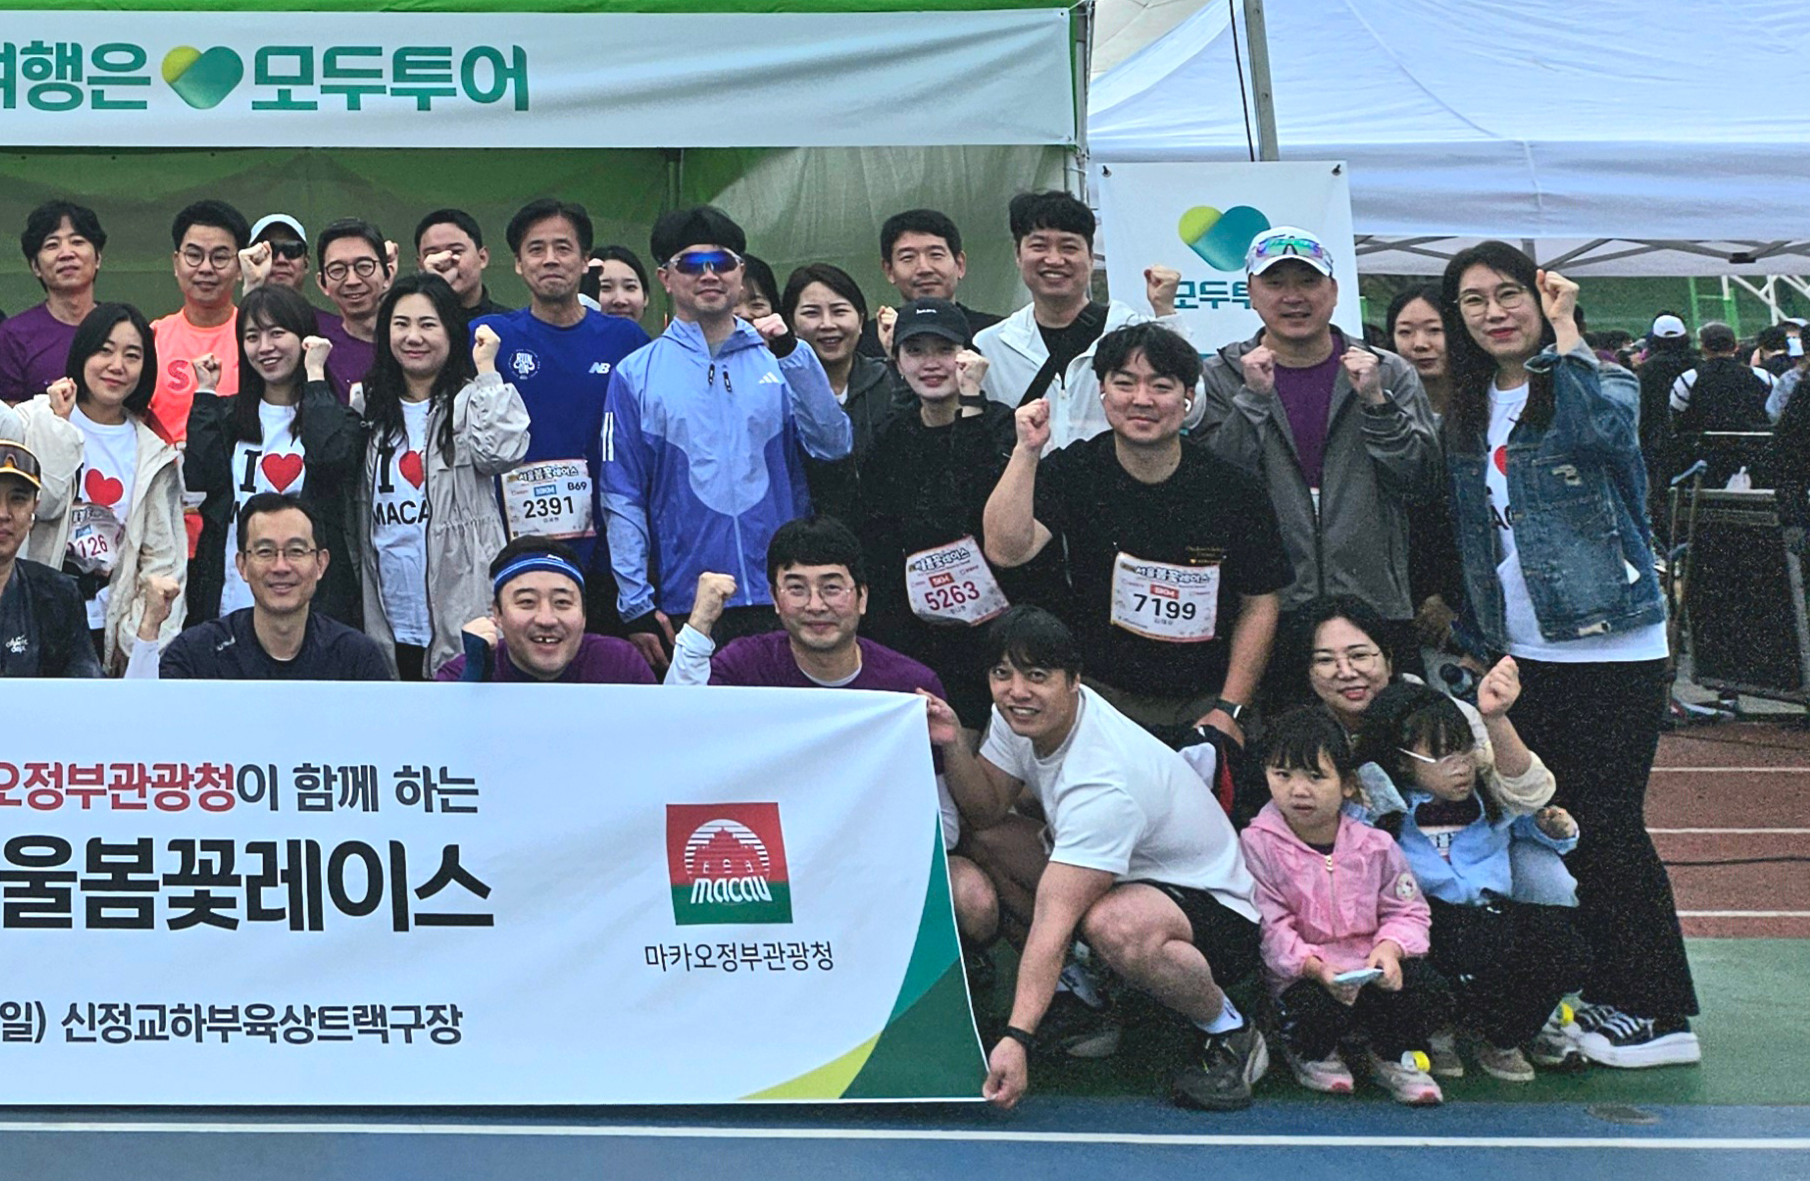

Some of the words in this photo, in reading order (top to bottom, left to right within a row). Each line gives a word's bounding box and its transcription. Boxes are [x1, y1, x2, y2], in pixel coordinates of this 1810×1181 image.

[251, 44, 530, 112] 모두투어
[239, 448, 263, 494] I
[567, 482, 588, 491] B69
[523, 496, 574, 519] 2391
[924, 581, 980, 611] 5263
[1133, 593, 1196, 620] 7199
[293, 763, 379, 812] 함께
[393, 765, 479, 813] 하는
[690, 875, 772, 904] macau
[644, 941, 834, 973] 마카오정부관광청
[60, 1001, 464, 1045] 신정교하부육상트랙구장
